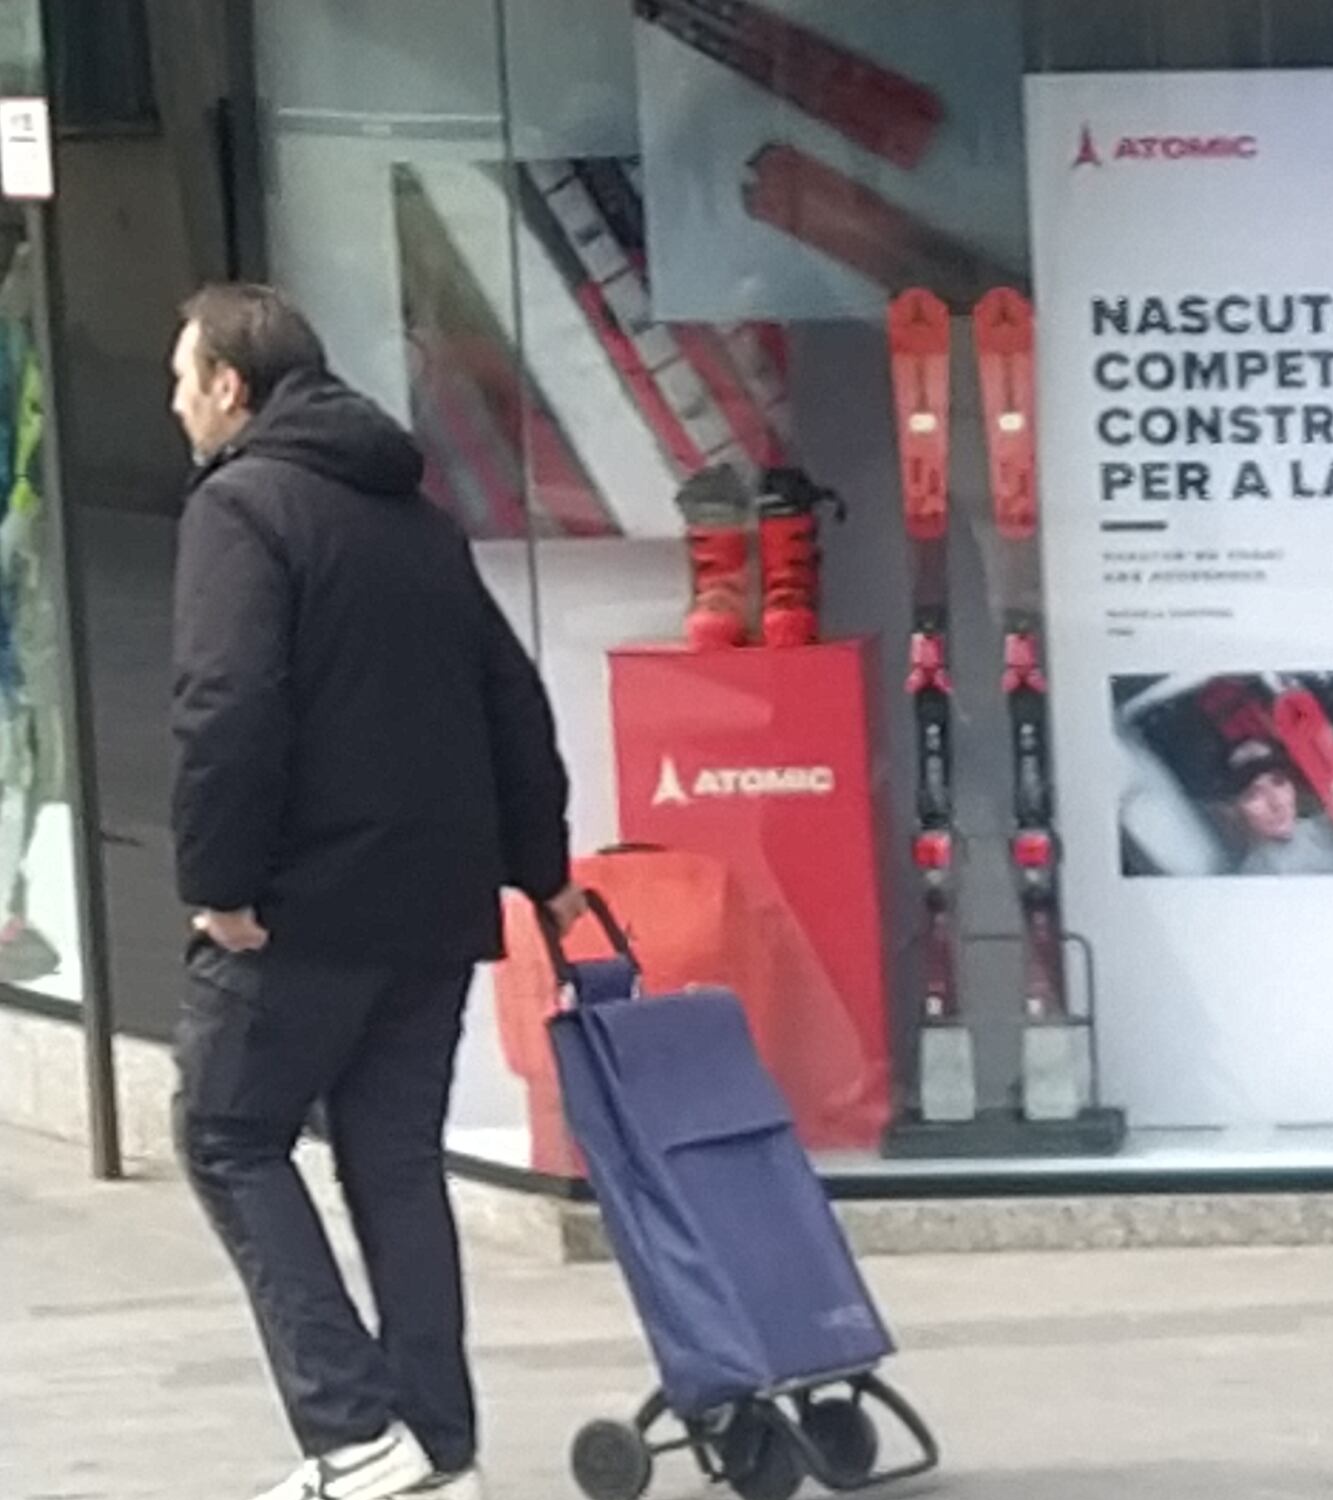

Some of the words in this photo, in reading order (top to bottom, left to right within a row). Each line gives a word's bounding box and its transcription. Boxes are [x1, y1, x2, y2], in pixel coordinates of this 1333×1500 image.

[1114, 136, 1257, 160] ATOMIC
[1100, 461, 1211, 500] PER
[1232, 458, 1272, 498] A
[692, 766, 836, 797] ATOMIC
